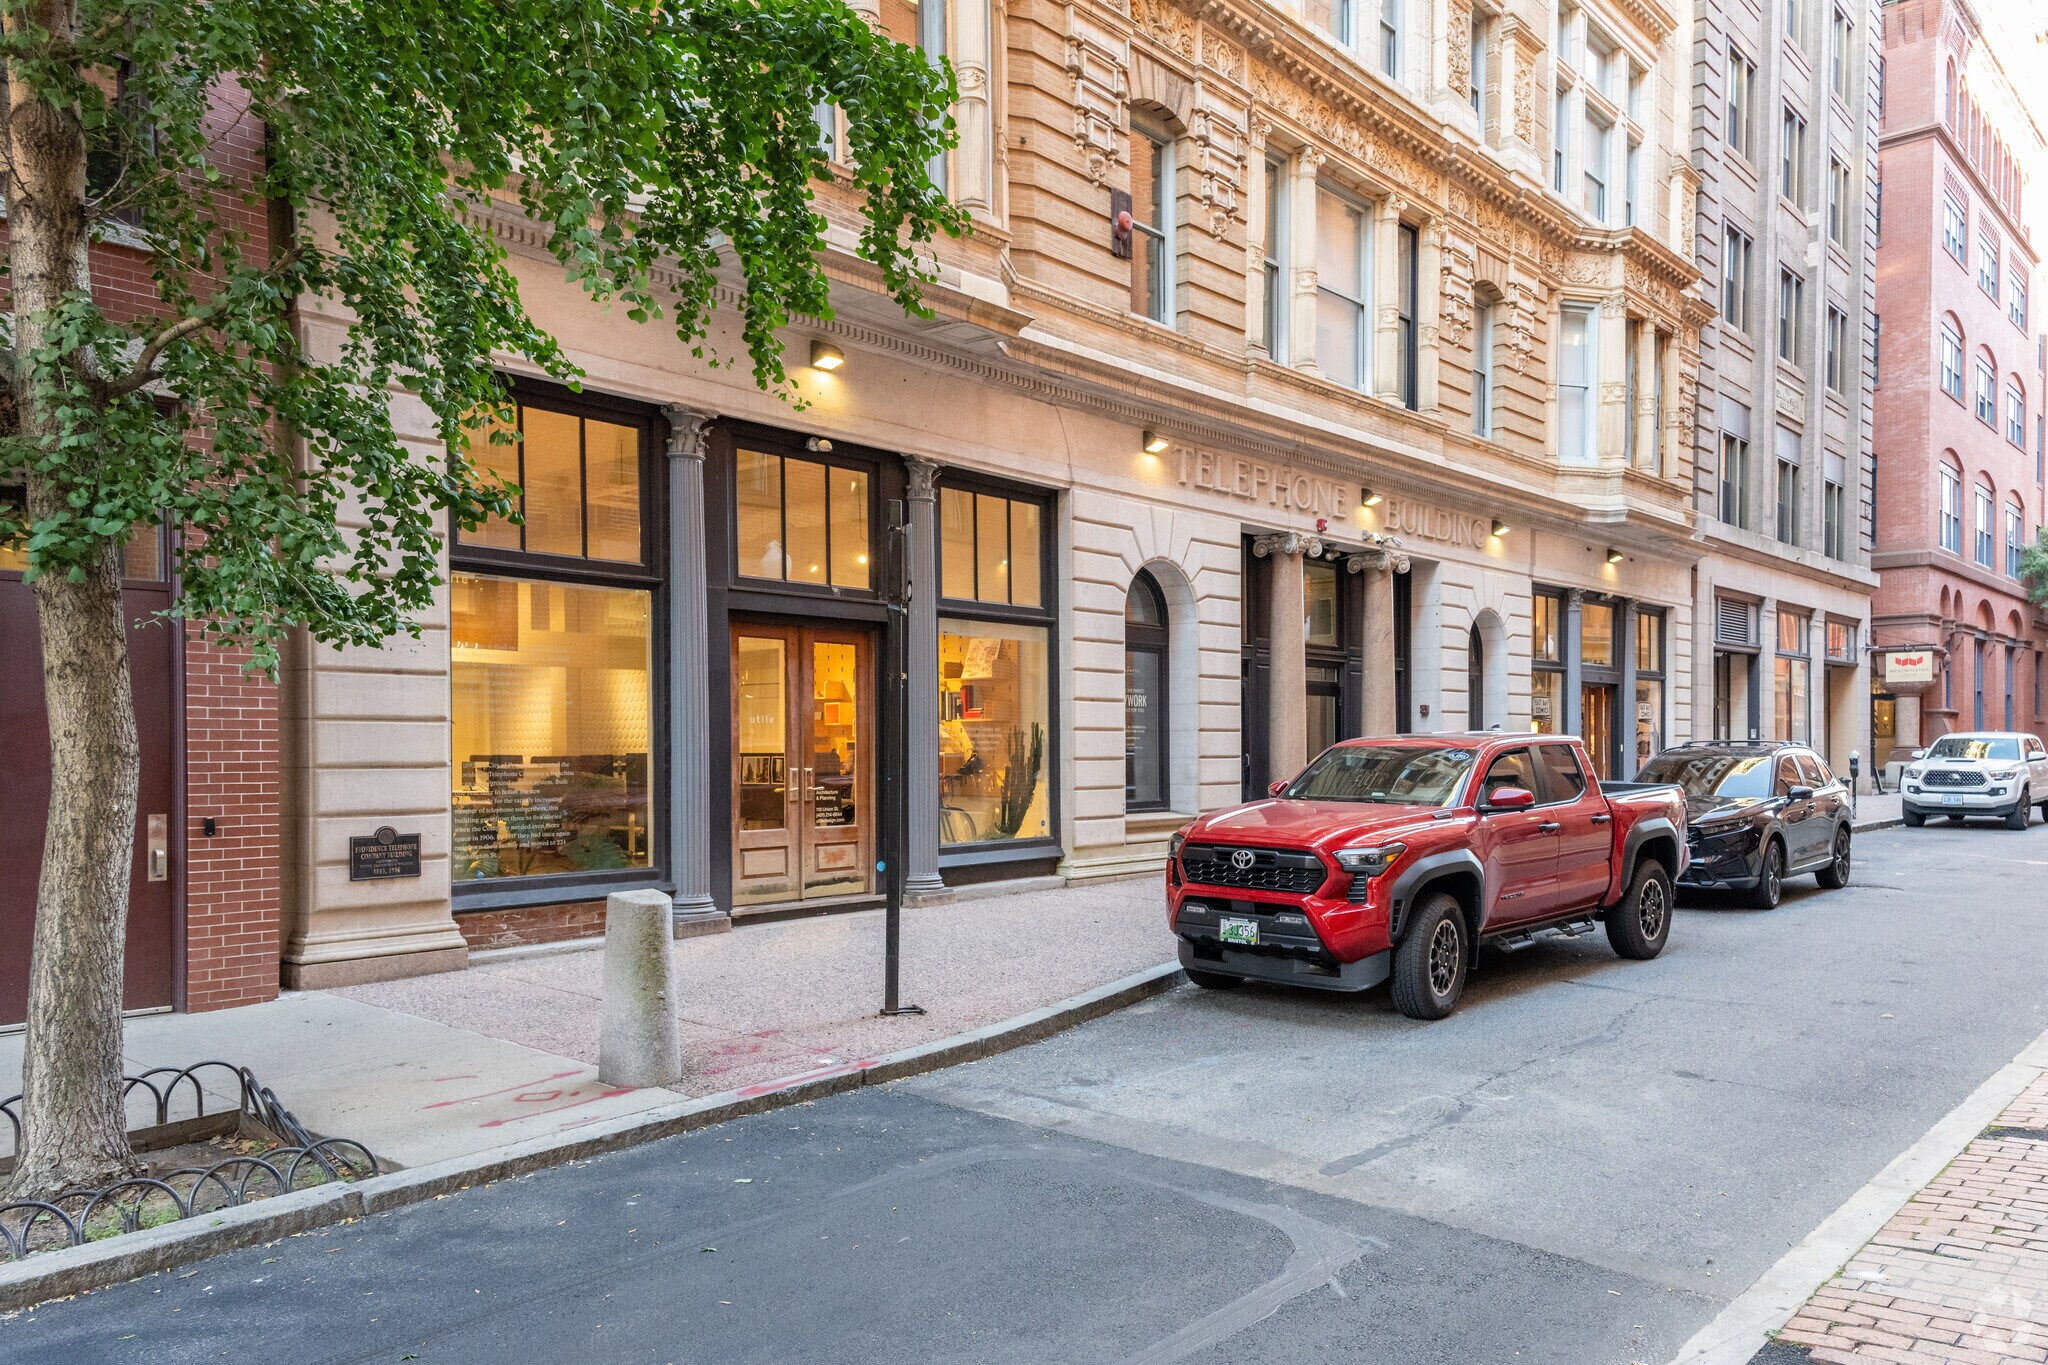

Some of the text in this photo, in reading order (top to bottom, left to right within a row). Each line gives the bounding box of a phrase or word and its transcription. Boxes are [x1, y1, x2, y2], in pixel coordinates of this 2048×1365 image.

[1174, 447, 1486, 548] TELEPHONE BUILDING
[750, 714, 774, 723] utile
[360, 852, 386, 860] COMPANY
